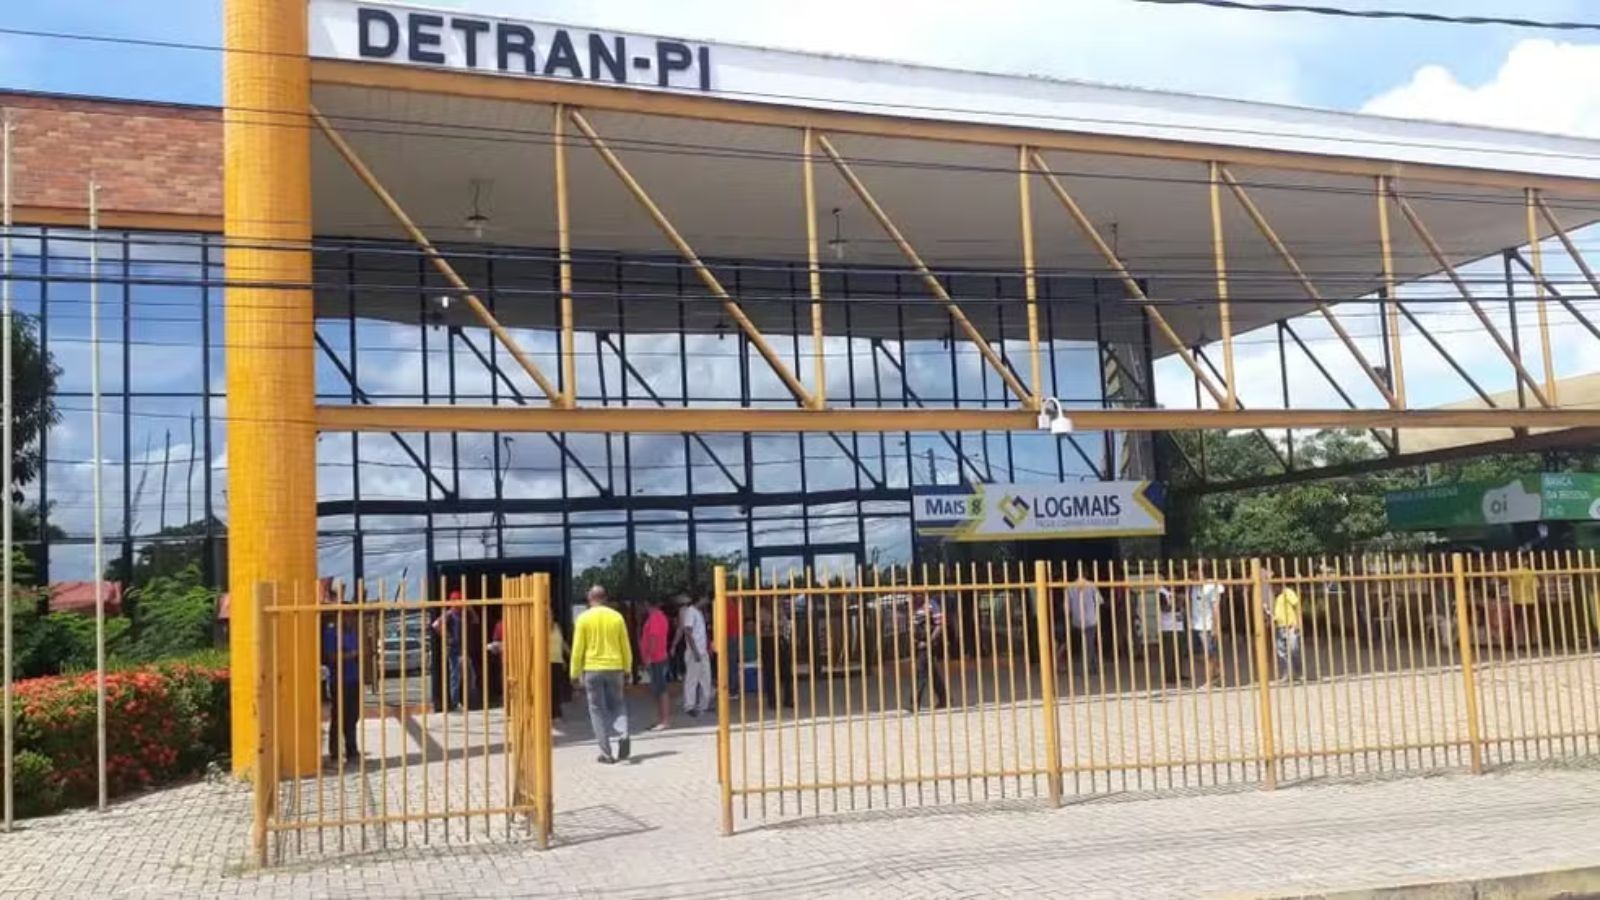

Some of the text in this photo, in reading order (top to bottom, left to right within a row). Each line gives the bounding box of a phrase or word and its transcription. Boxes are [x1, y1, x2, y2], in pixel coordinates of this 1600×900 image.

[358, 8, 710, 91] DETRAN-PI
[1034, 495, 1121, 518] LOGMAIS
[1490, 494, 1508, 514] oi
